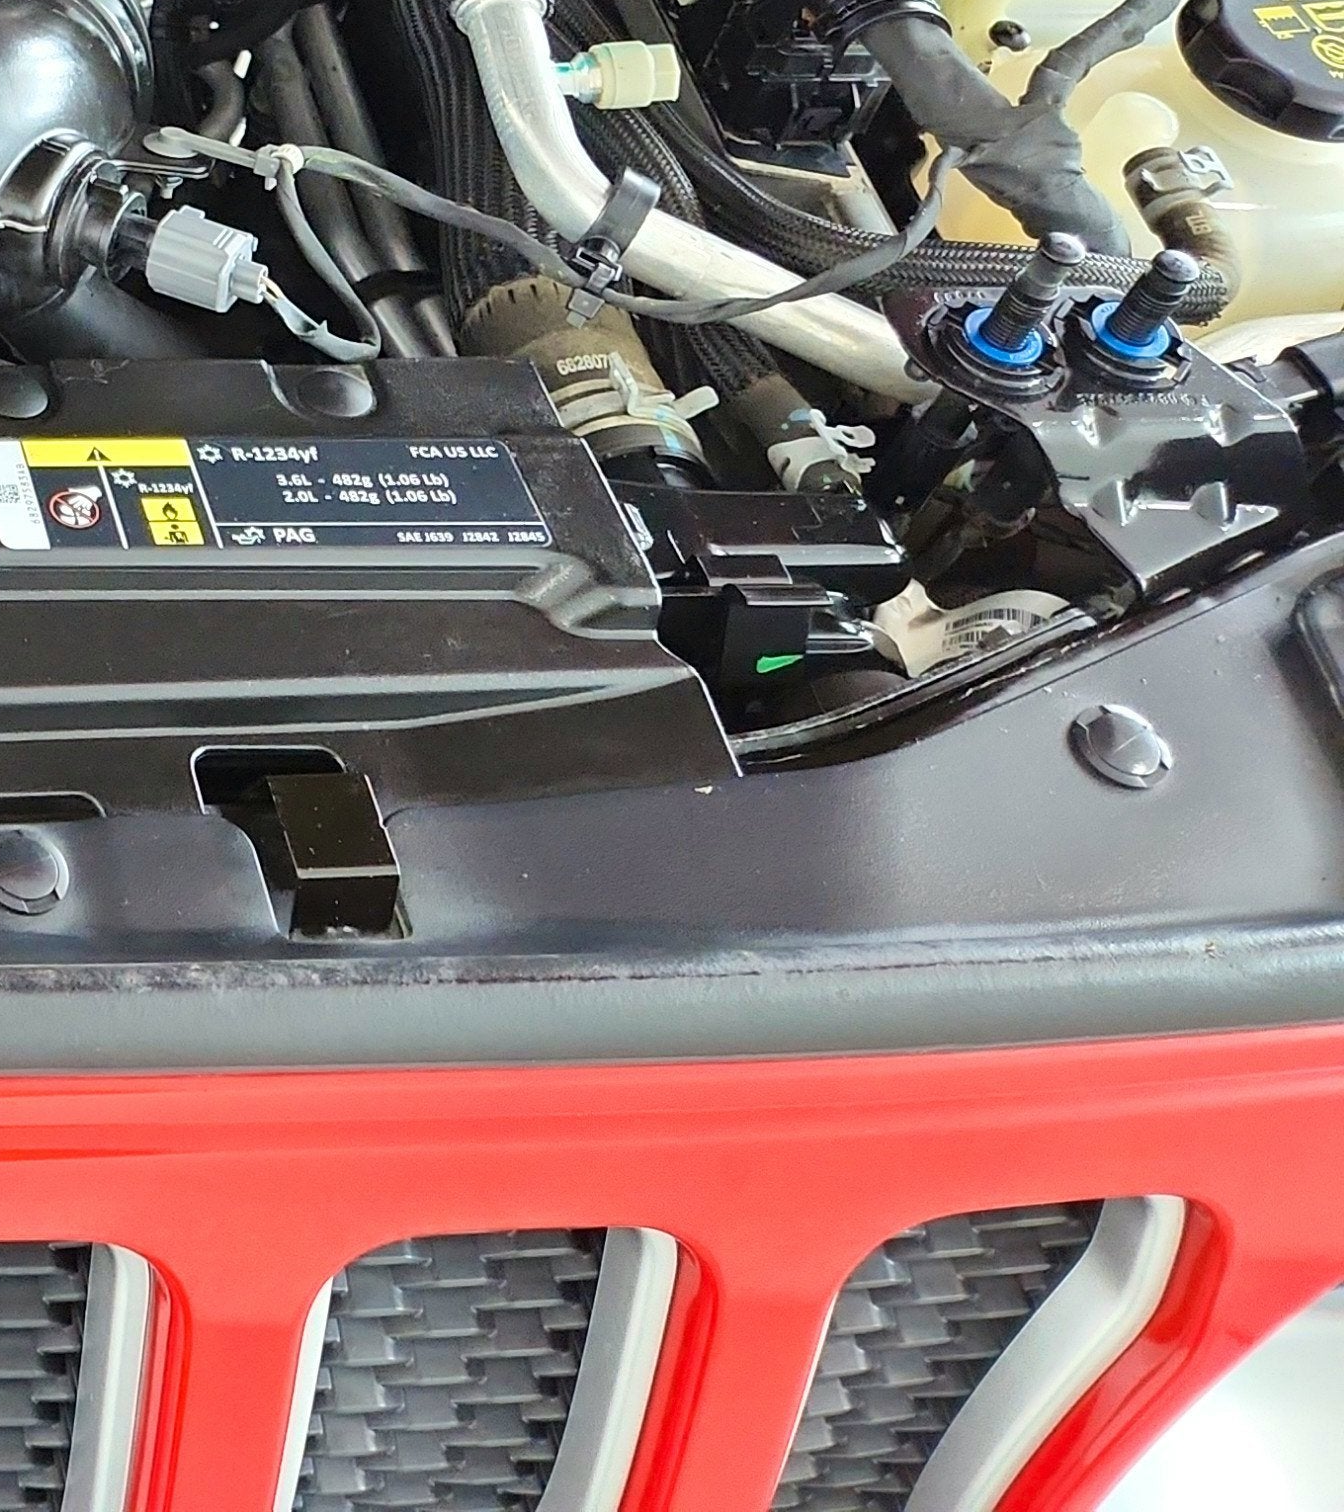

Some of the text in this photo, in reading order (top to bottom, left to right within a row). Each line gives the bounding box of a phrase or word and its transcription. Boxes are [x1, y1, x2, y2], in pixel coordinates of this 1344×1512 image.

[230, 445, 319, 464] R-1234yf
[409, 445, 499, 459] FCA US LLC
[137, 481, 194, 496] R-1234yf
[275, 473, 313, 487] 3.6L
[332, 473, 373, 489] 482g
[378, 473, 421, 489] (1.06
[421, 473, 450, 489] Lb)
[282, 489, 319, 503] 2.0L
[338, 489, 381, 505] 482g
[385, 489, 429, 505] (1.06
[429, 489, 458, 505] Lb)
[272, 526, 316, 544] PAG
[396, 531, 423, 543] SAE
